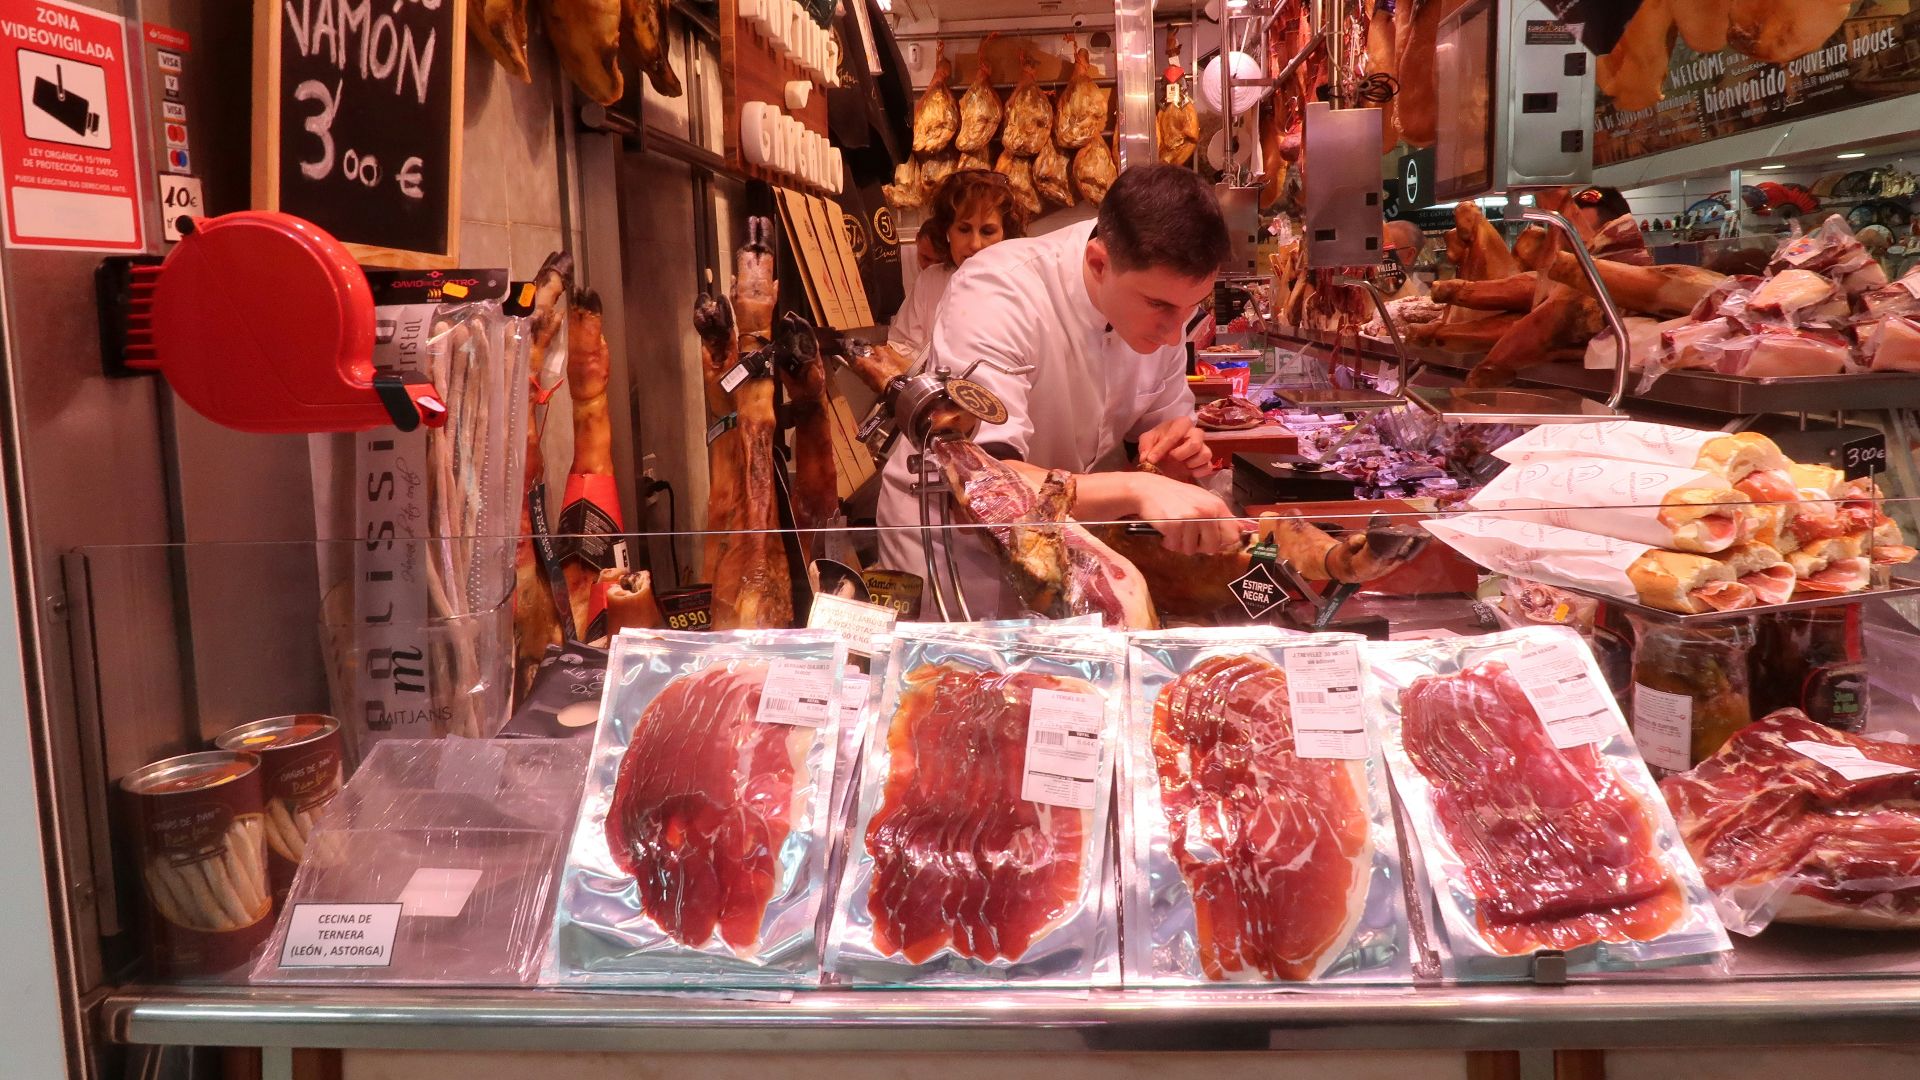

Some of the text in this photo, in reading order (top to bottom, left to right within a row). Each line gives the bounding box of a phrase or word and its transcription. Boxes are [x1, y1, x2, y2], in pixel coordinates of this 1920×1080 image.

[36, 7, 81, 33] ZONA
[1, 19, 115, 62] VIDEOVIGILADA
[160, 54, 180, 67] VISA
[1788, 27, 1897, 78] SOUVENIR HOUSE
[1670, 51, 1727, 90] WELCOME
[1703, 68, 1786, 114] bienvenido
[166, 103, 184, 117] VISA
[29, 148, 42, 157] LEY
[22, 158, 119, 178] DE PROTECCIÓN DE DATOS
[395, 156, 425, 199] €
[1242, 579, 1274, 595] ESTIRPE
[1242, 589, 1270, 604] NEGRA
[378, 706, 453, 727] MITJANS
[318, 914, 373, 924] CECINA DE
[318, 930, 365, 940] TERNERA
[290, 943, 323, 958] (LEÓN
[329, 945, 385, 958] ASTORGA)
